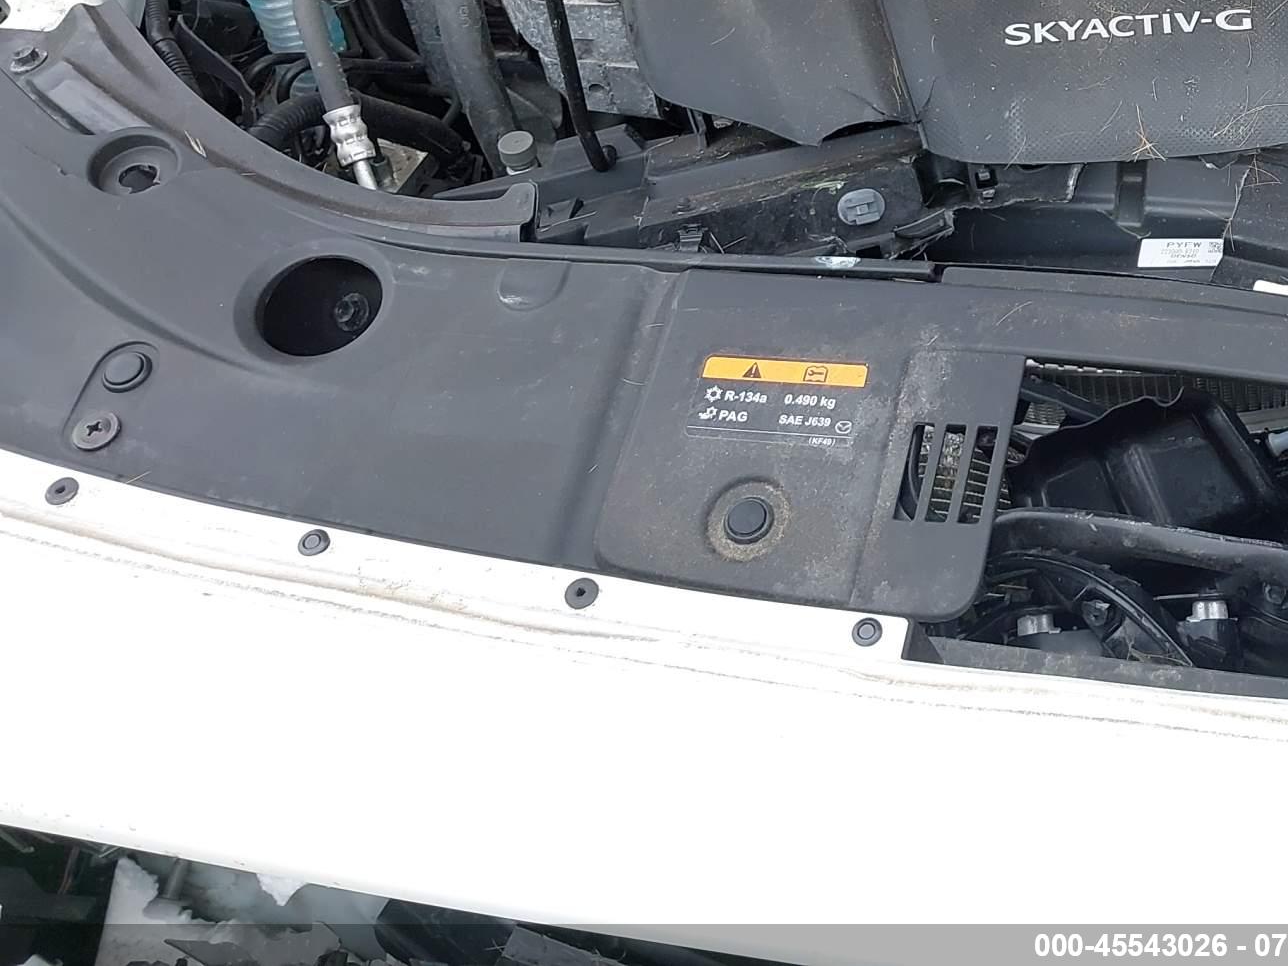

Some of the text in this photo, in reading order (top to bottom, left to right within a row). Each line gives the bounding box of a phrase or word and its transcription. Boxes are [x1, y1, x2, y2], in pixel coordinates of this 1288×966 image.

[724, 390, 836, 410] R-134a 0.490 kg
[718, 410, 832, 427] PAG SAE J639
